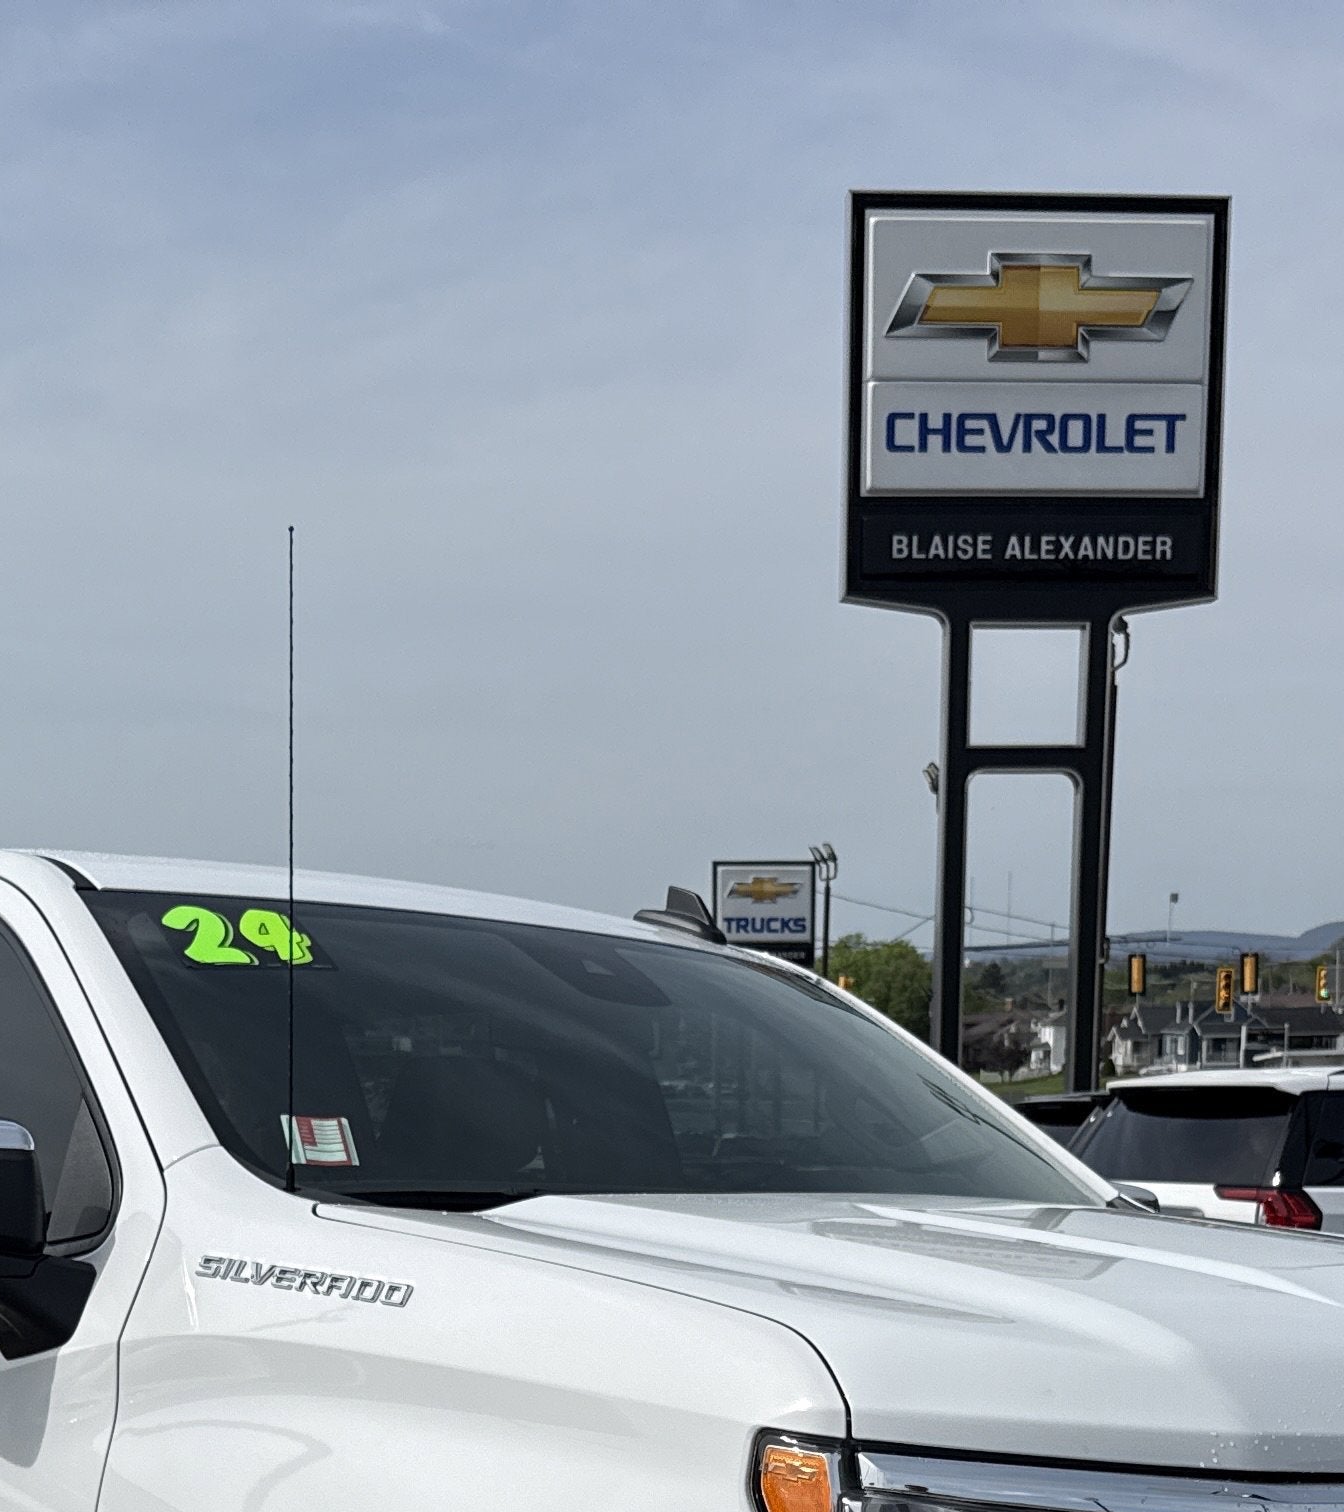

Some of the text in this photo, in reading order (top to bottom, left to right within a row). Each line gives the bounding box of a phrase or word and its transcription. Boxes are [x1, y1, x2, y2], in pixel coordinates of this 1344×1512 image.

[885, 412, 1187, 455] CHEVROLET
[891, 535, 1173, 562] BLAISE ALEXANDER
[722, 917, 807, 934] TRUCKS
[195, 1254, 415, 1308] SILVERADO
